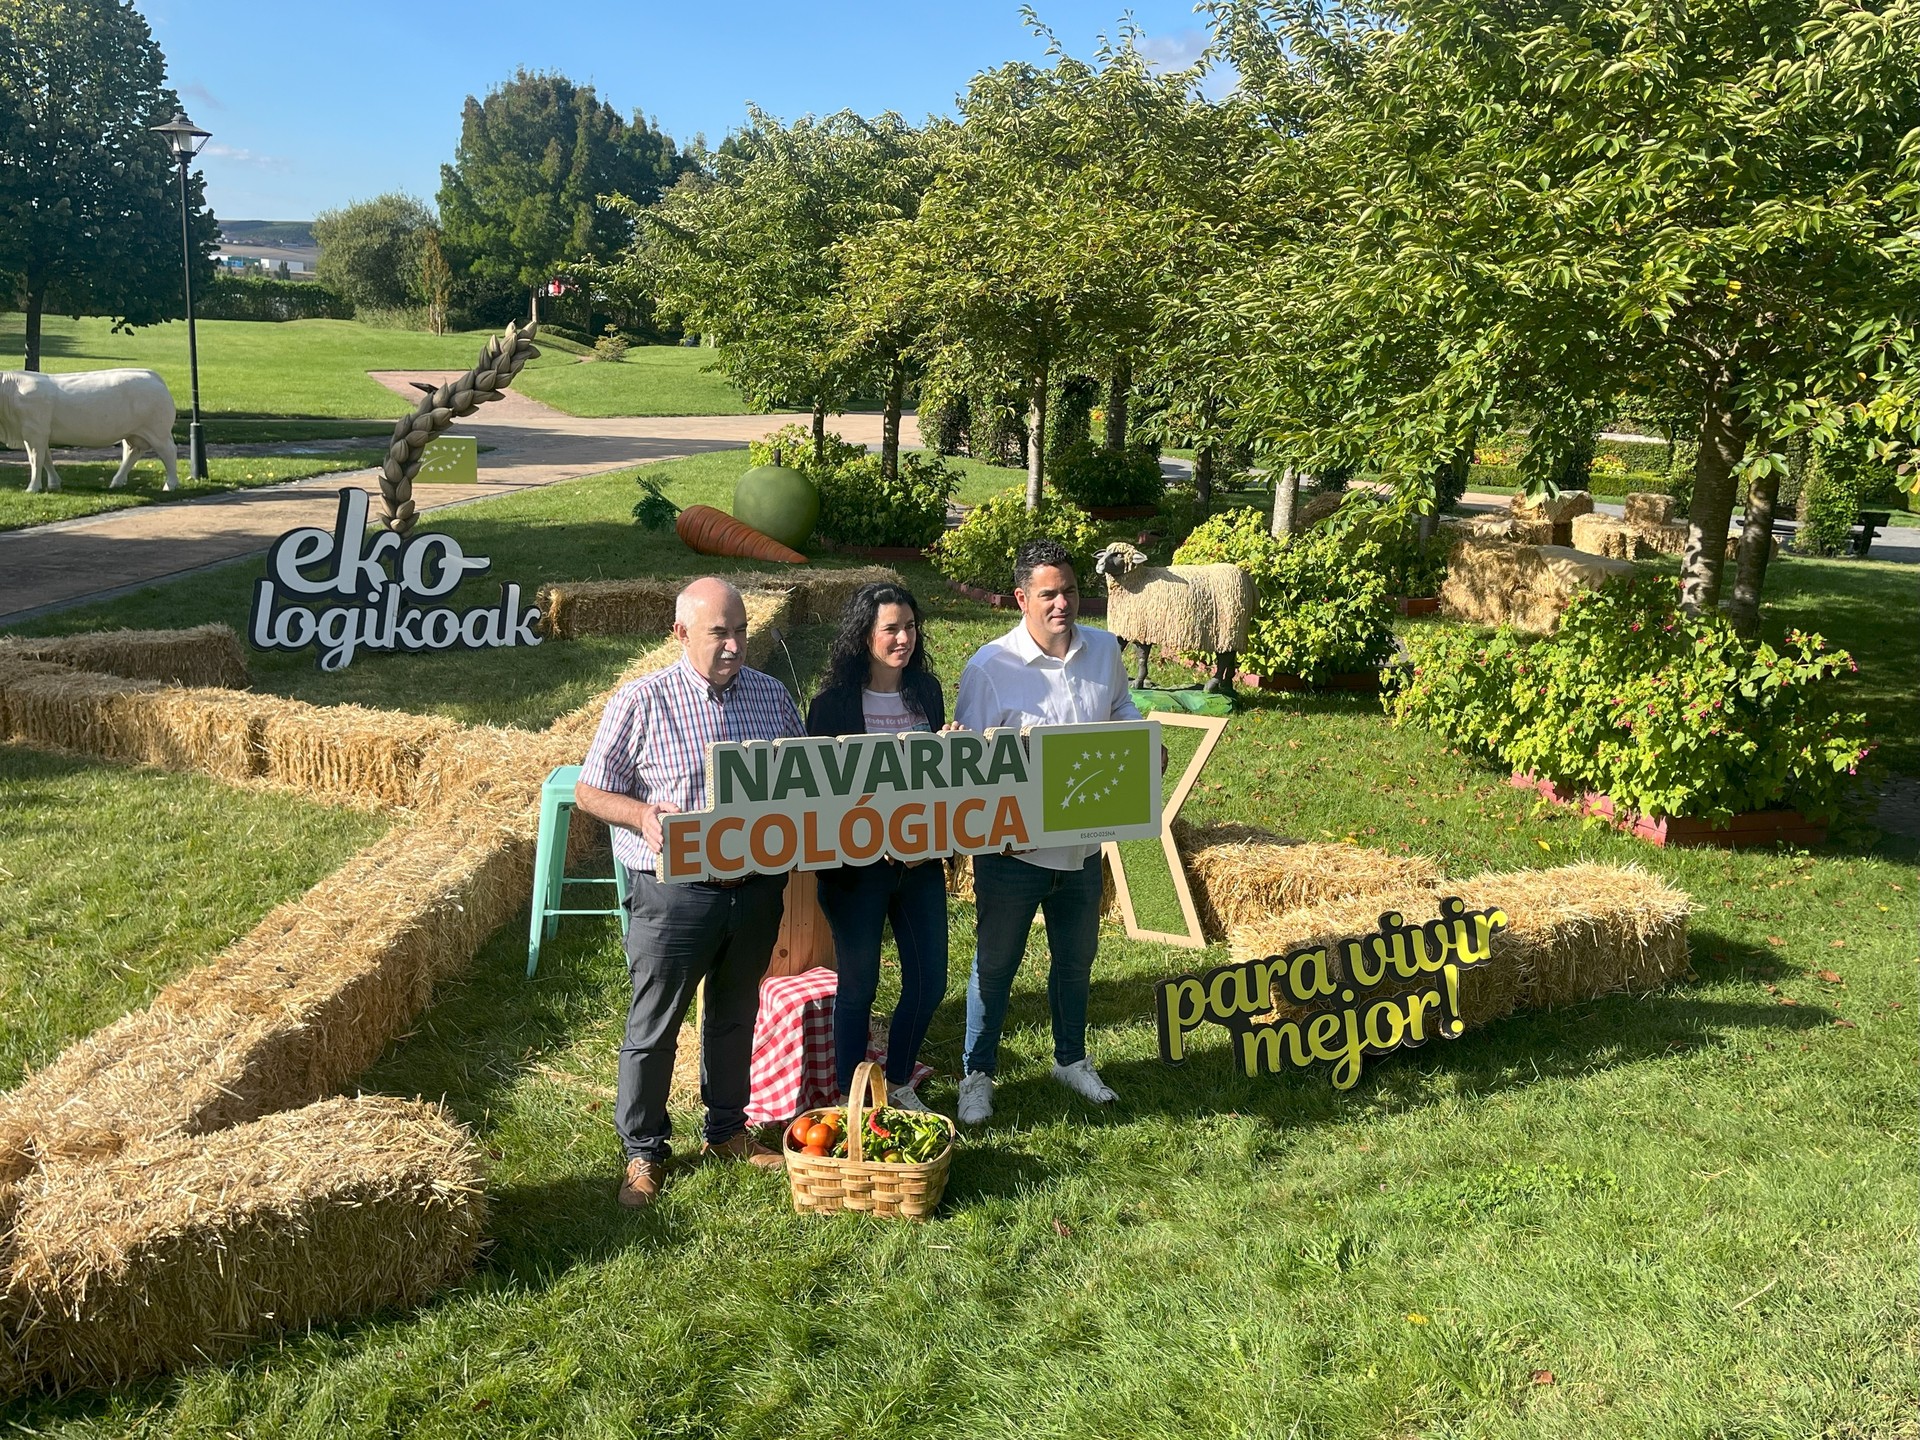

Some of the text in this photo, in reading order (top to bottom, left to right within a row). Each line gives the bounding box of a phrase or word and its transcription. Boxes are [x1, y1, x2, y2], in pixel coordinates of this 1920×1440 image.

[275, 488, 491, 596] eko
[253, 580, 543, 672] logikoak
[719, 734, 1029, 804] NAVARRA
[669, 794, 1031, 877] ECOLÓGICA
[1165, 900, 1508, 1061] para vivir
[1242, 963, 1465, 1090] mejor!
